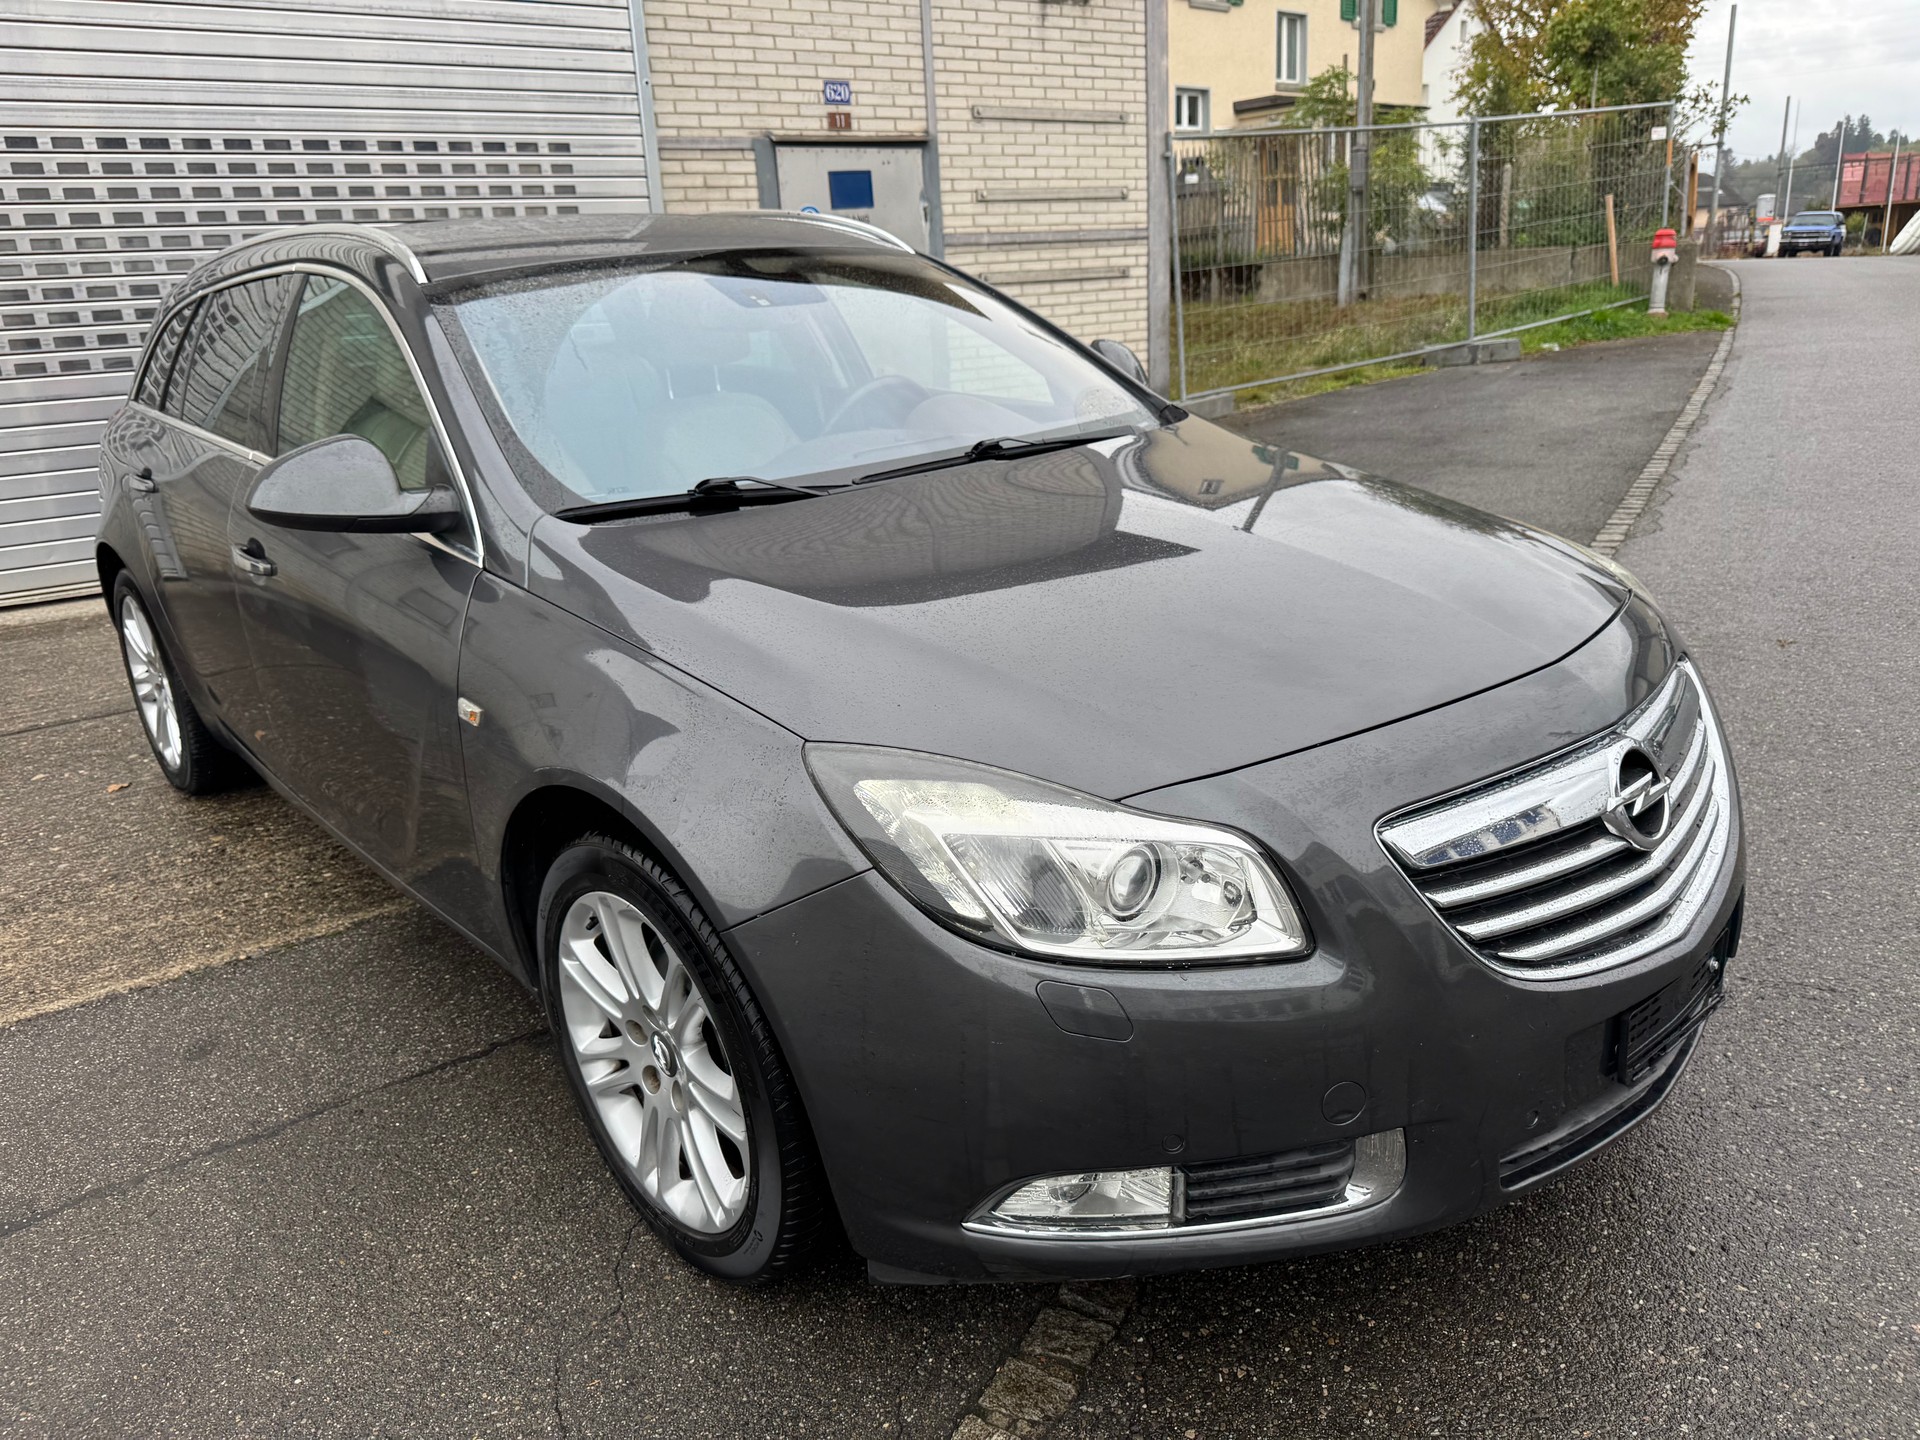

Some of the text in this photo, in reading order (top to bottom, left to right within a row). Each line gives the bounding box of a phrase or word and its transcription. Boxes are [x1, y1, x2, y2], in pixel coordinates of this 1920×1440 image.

[826, 84, 849, 102] 620
[835, 114, 845, 128] 11
[632, 874, 720, 1001] MICHELIN
